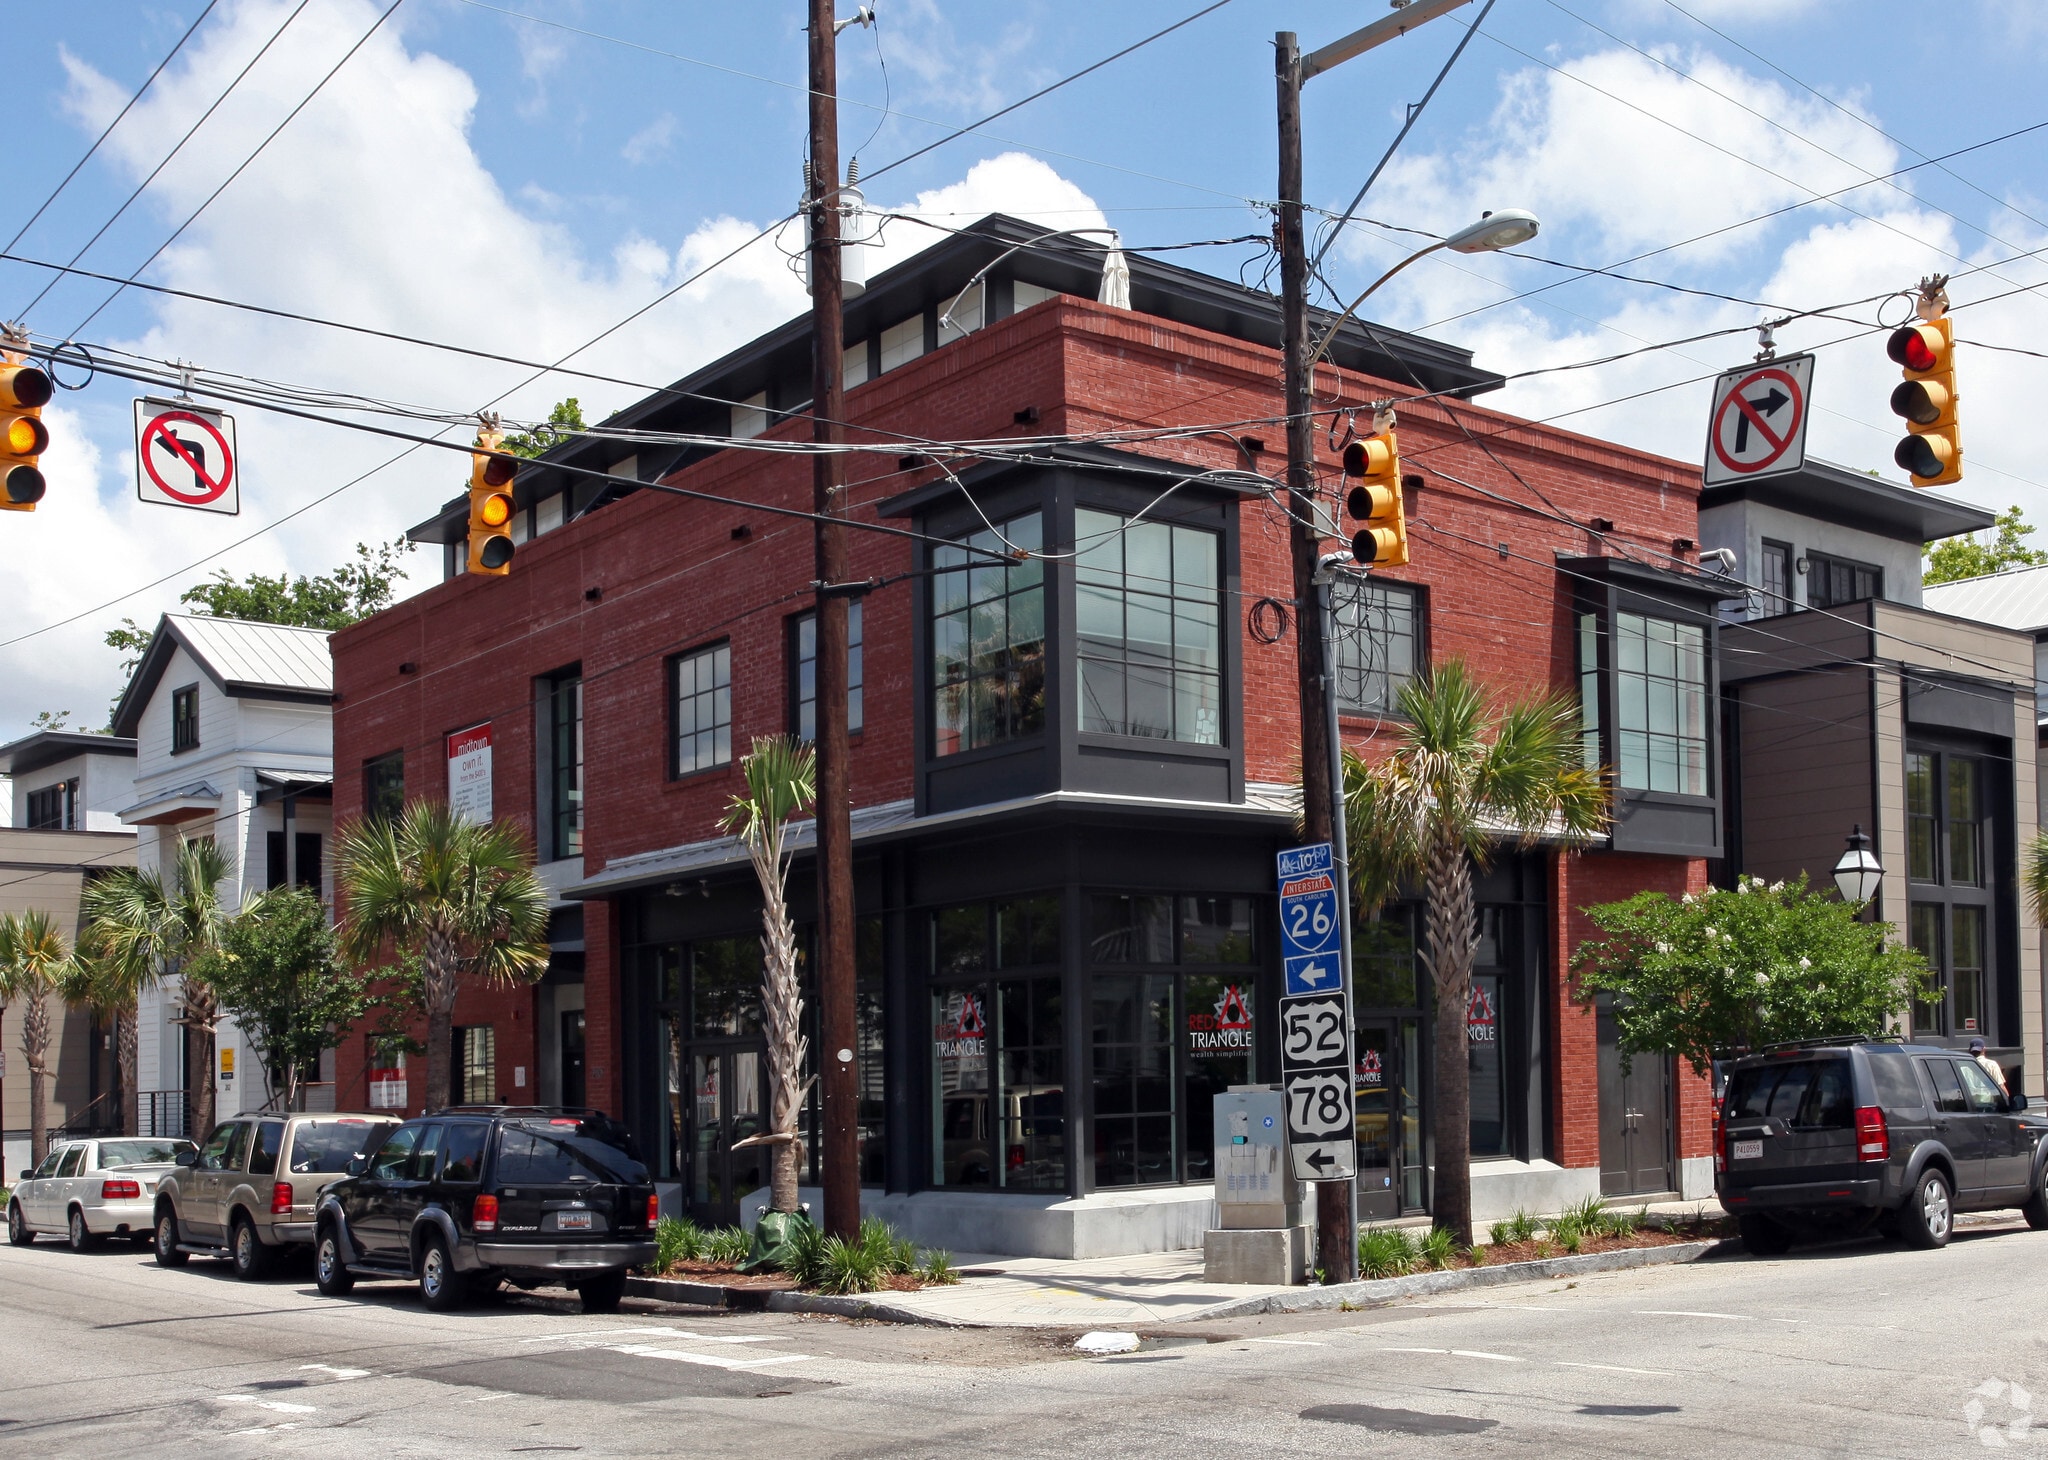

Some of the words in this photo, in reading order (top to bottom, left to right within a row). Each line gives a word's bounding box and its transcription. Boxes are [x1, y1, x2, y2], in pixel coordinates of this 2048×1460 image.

[458, 737, 488, 756] midtown
[462, 758, 476, 771] own
[1286, 879, 1327, 895] INTERSTATE
[1287, 896, 1303, 904] SOUTH
[1304, 892, 1328, 901] CAROLINA
[1290, 901, 1330, 938] 26
[1188, 1014, 1214, 1031] RED
[1190, 1031, 1252, 1049] TRIANGLE
[1290, 1011, 1340, 1054] 52
[1466, 1026, 1494, 1041] NGLE
[935, 1039, 985, 1057] TRIANGLE
[1190, 1050, 1214, 1058] wealth
[1216, 1050, 1252, 1058] simplified
[1353, 1072, 1382, 1083] RIANGLE
[1292, 1084, 1343, 1126] 78
